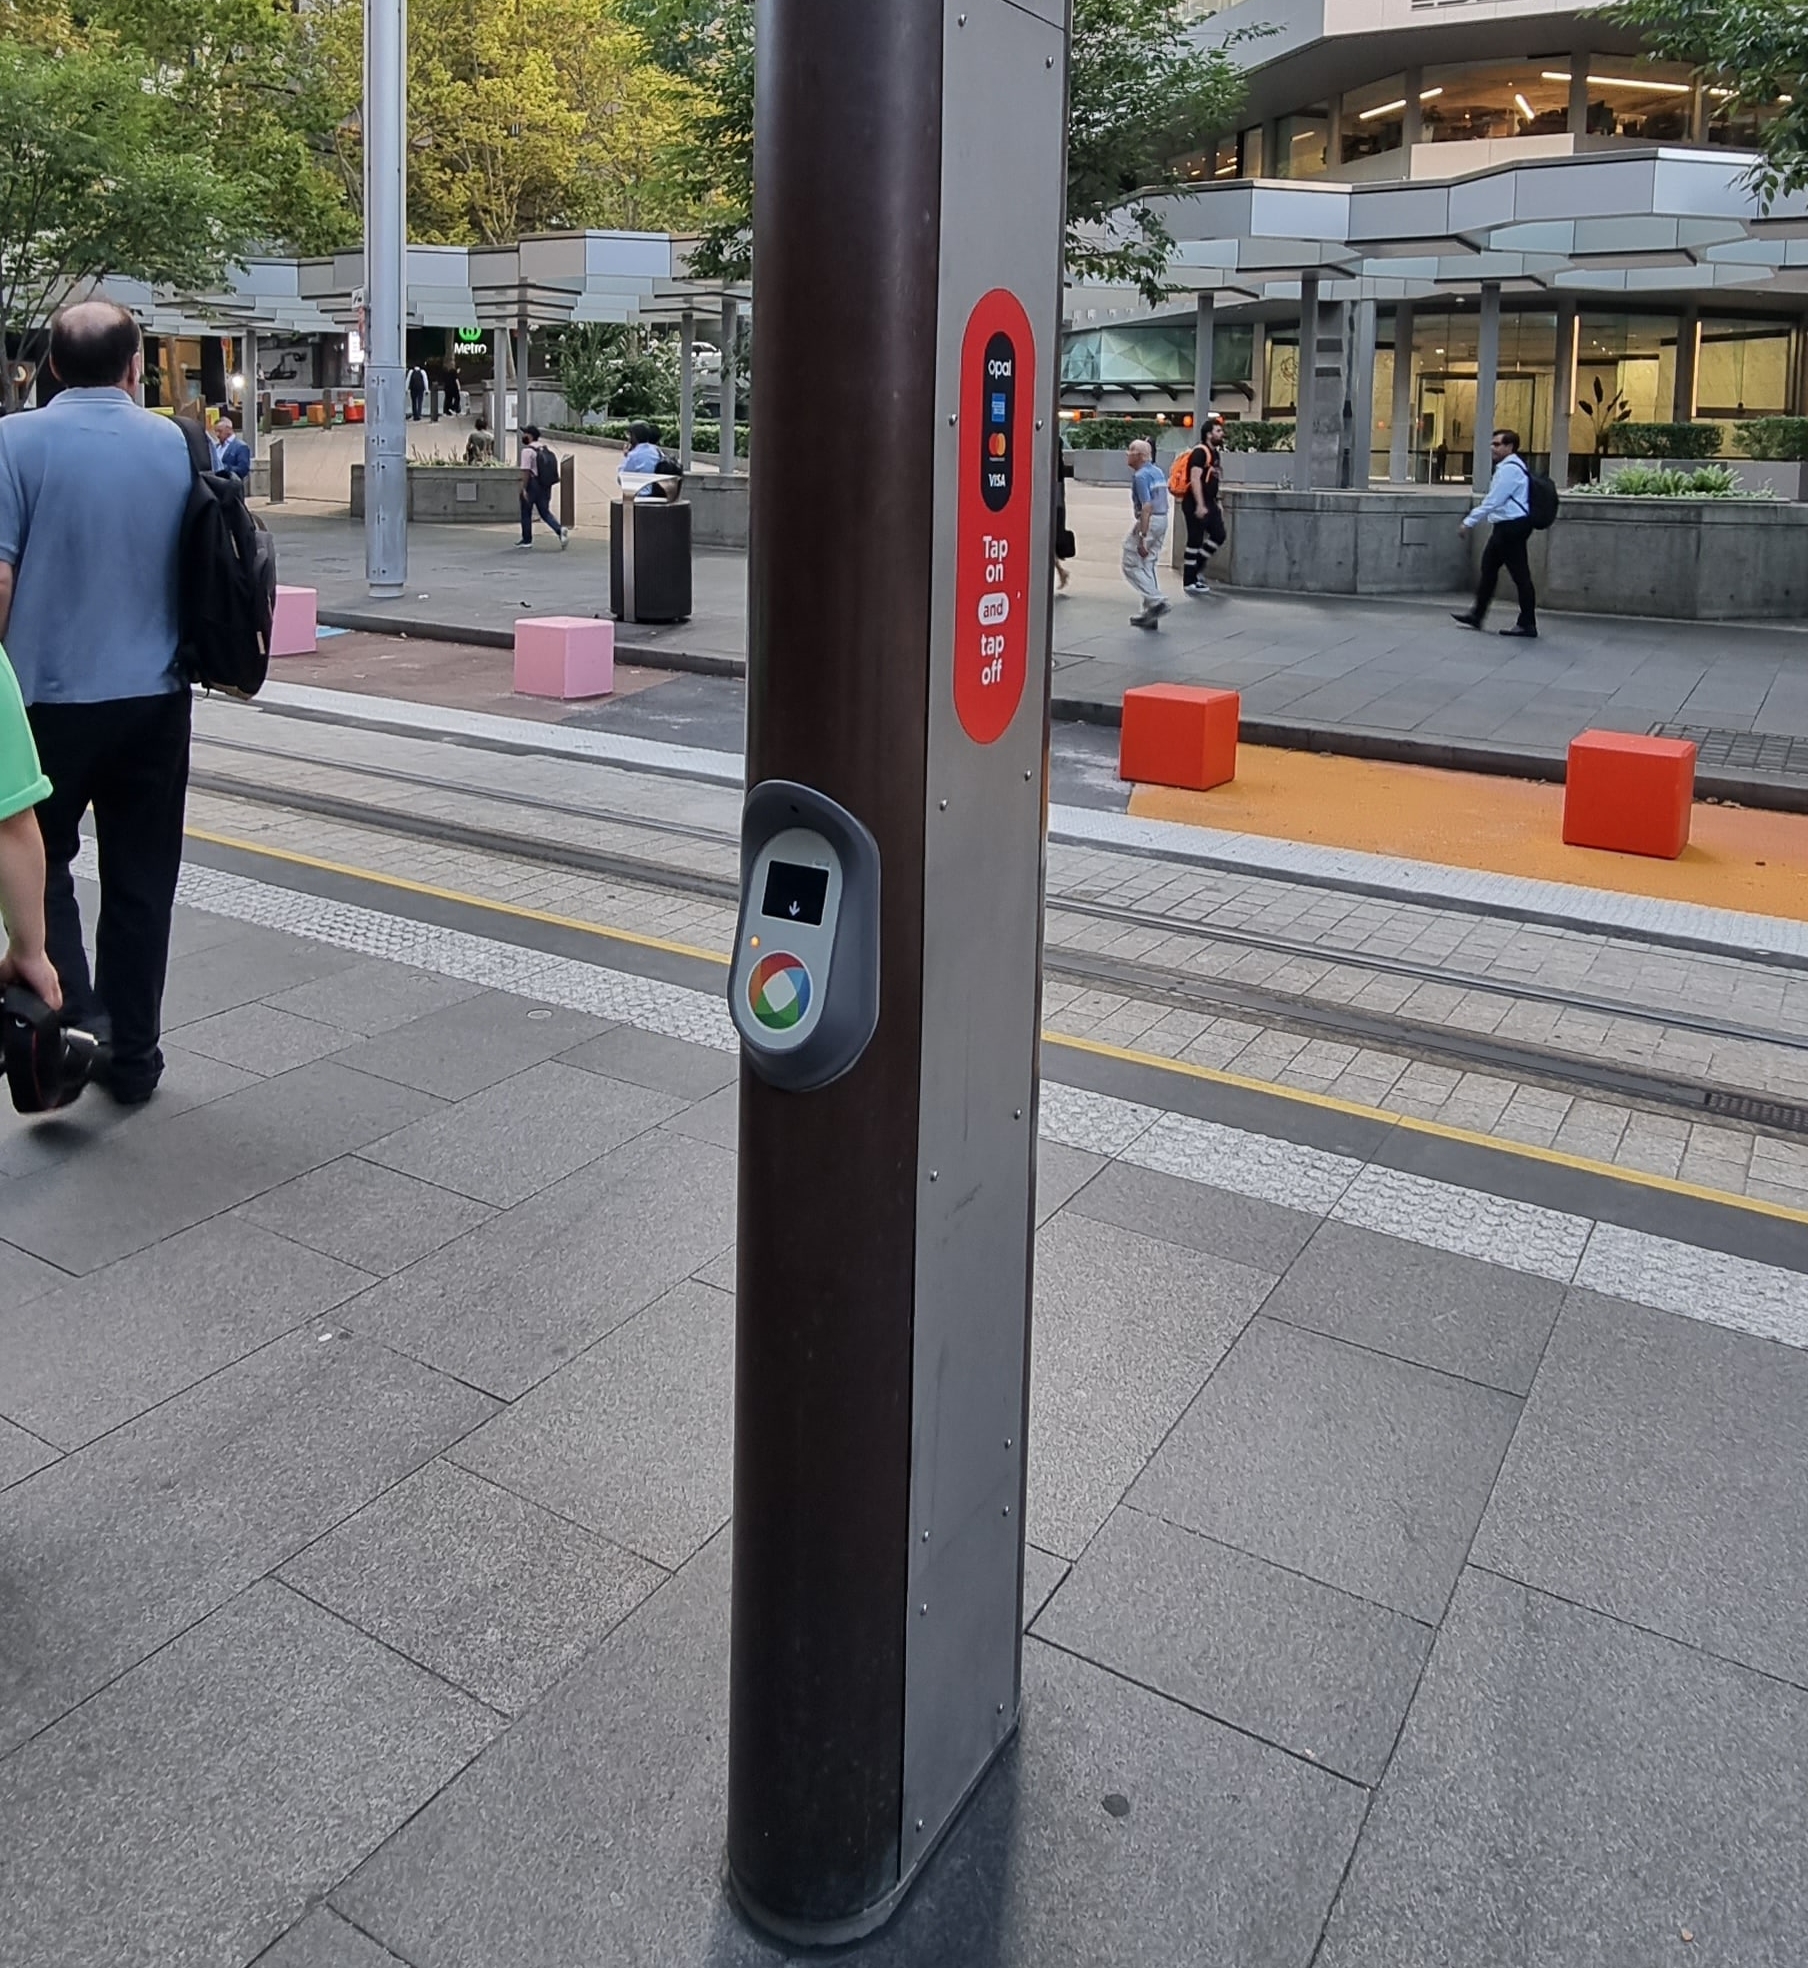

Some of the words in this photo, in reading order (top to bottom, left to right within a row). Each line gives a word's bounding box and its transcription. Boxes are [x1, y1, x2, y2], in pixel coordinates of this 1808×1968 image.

[454, 342, 487, 355] Metro
[988, 359, 1012, 379] opal
[988, 473, 1006, 488] VISA
[982, 535, 1009, 562] Tap
[985, 563, 1004, 583] on
[982, 599, 1004, 619] and
[980, 633, 1005, 658] tap
[980, 659, 1003, 686] off
